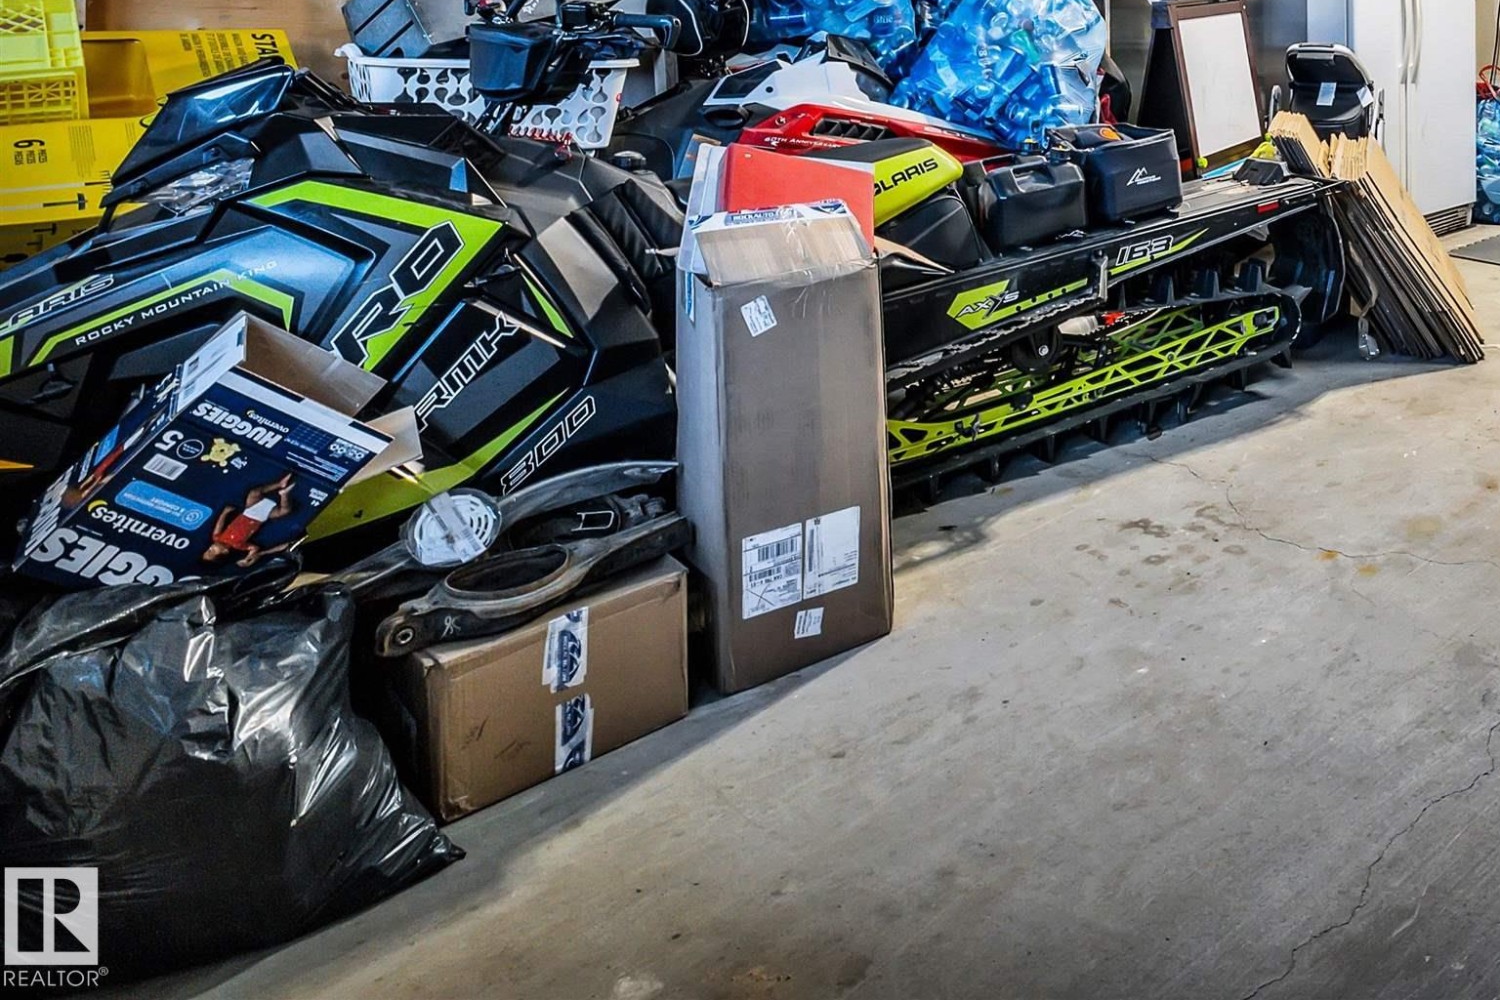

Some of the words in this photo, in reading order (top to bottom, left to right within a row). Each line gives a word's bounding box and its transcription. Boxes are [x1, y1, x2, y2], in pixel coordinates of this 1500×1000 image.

[13, 139, 45, 149] 6
[874, 157, 939, 197] OLARIS
[1116, 235, 1174, 267] 163
[74, 315, 135, 347] ROCKY
[140, 278, 231, 319] MOUNTAIN
[236, 259, 279, 282] KING
[957, 289, 1020, 319] AXYS
[413, 311, 522, 435] RMK
[158, 429, 186, 451] 5
[192, 401, 283, 449] HUGGIES
[248, 410, 291, 435] overnites
[500, 395, 597, 497] 800
[90, 504, 191, 550] overnites
[28, 526, 198, 588] GGIES
